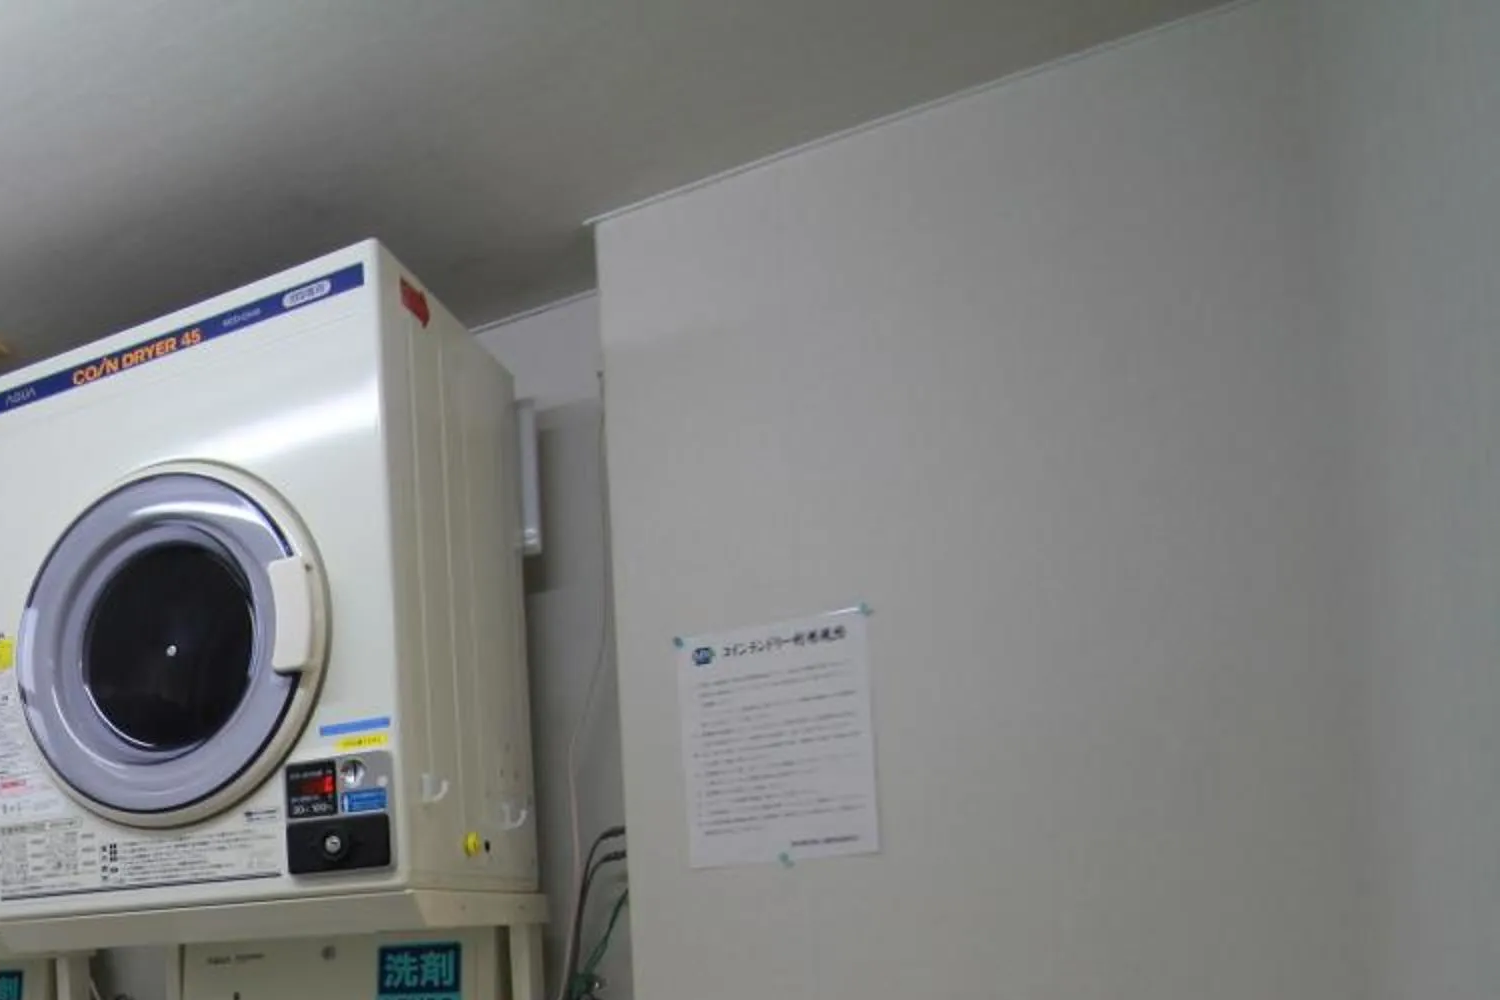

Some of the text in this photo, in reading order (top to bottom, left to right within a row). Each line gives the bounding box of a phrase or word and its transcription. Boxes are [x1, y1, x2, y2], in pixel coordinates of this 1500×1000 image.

[5, 386, 36, 406] AQUA
[121, 336, 178, 370] DRYER
[181, 328, 201, 347] 45
[384, 951, 455, 988] 洗剤
